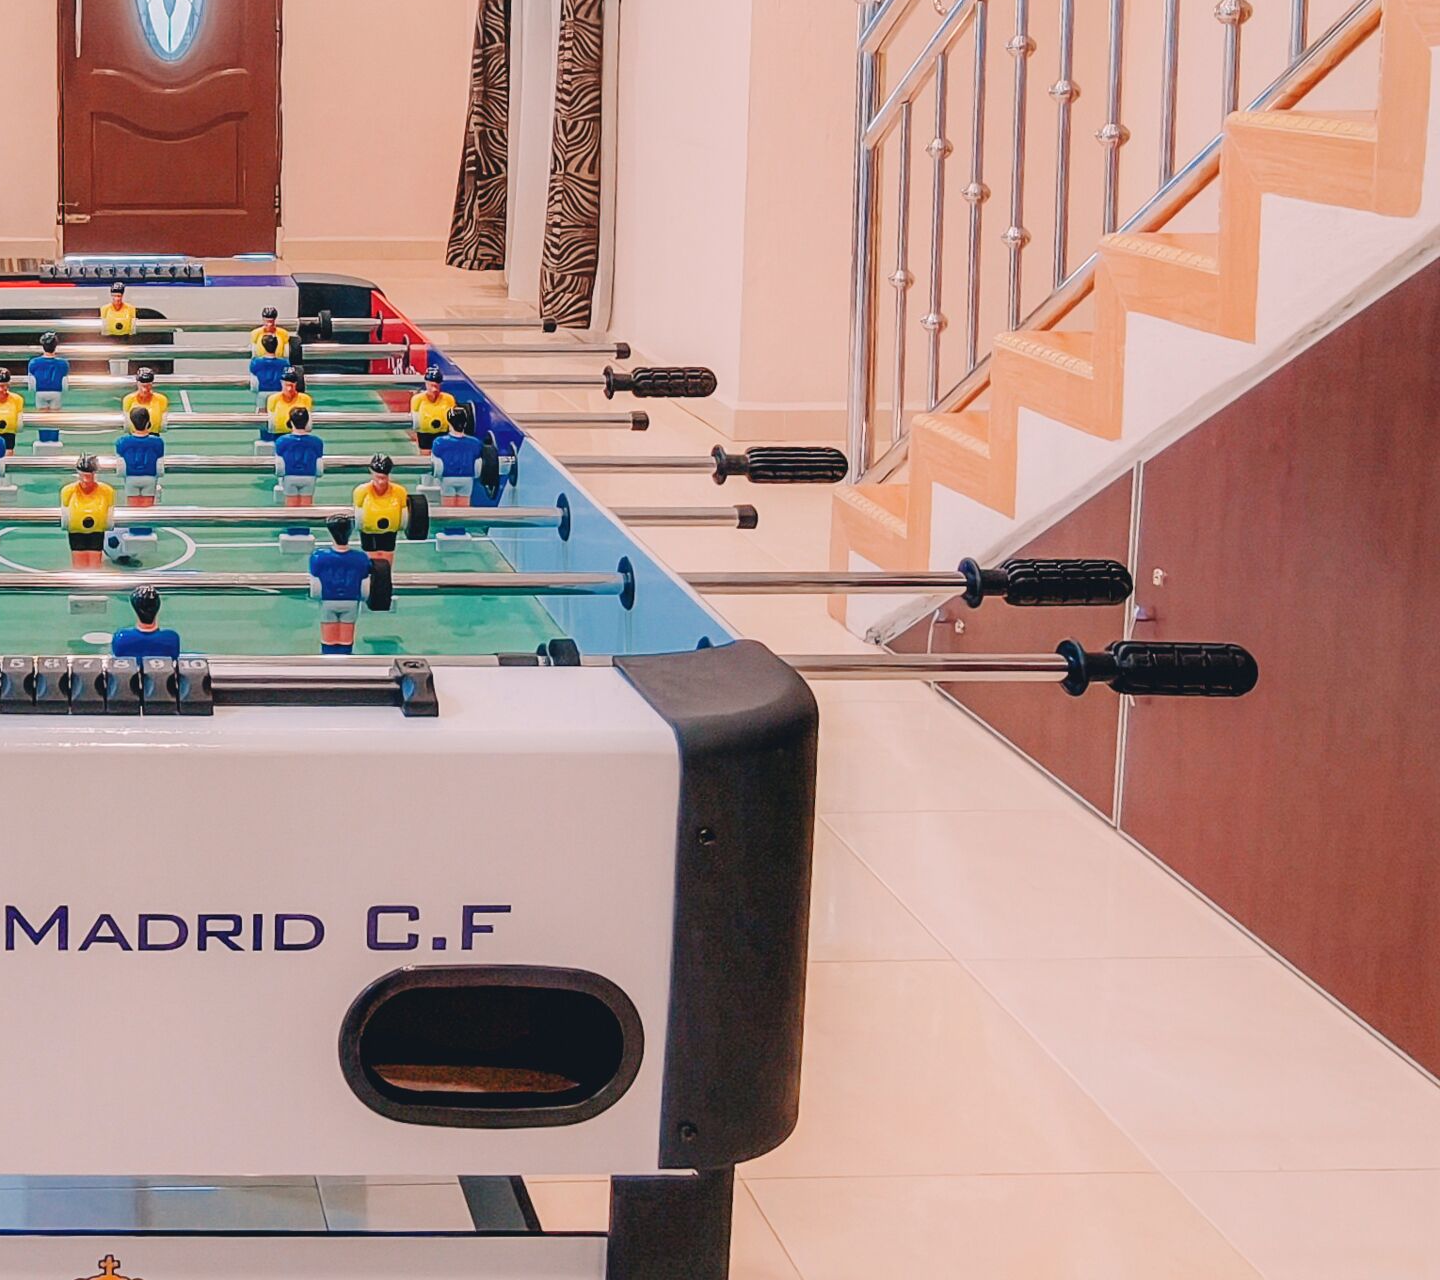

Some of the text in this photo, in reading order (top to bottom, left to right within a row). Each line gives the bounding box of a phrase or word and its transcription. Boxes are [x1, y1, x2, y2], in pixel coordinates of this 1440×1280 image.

[10, 658, 25, 668] 5
[44, 658, 60, 668] 6
[78, 659, 94, 668] 7
[114, 658, 130, 668] 8
[149, 658, 165, 669] 9
[180, 659, 207, 669] 10
[366, 904, 512, 951] C.F
